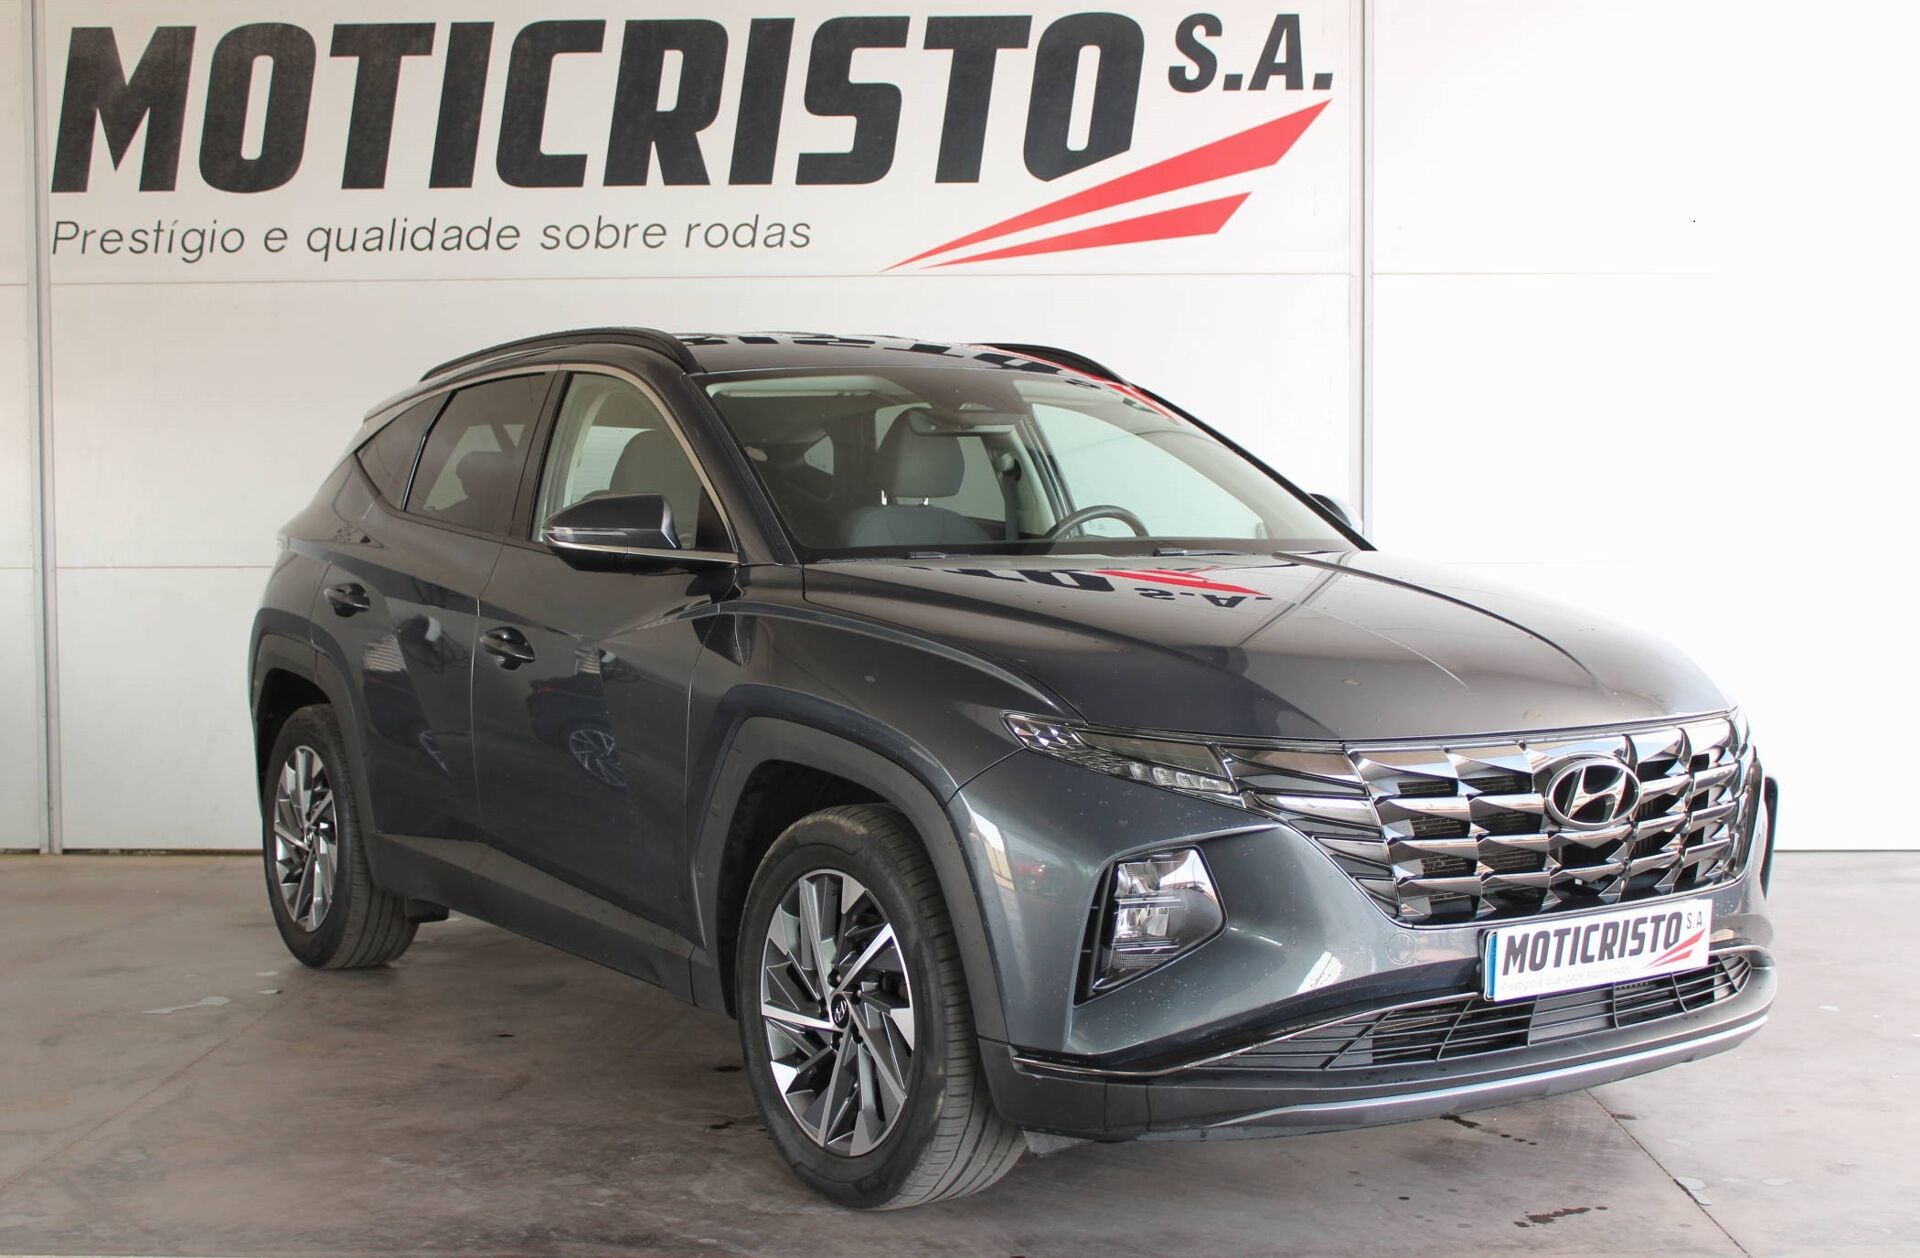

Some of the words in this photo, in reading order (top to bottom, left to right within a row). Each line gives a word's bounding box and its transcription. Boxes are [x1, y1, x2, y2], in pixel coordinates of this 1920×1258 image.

[51, 13, 1145, 193] MOTICRISTO
[1168, 14, 1333, 92] S.A.
[52, 219, 246, 264] Prestígio
[264, 226, 288, 253] e
[306, 216, 521, 262] qualidade
[540, 214, 668, 251] sobre
[685, 214, 811, 249] rodas
[1502, 911, 1683, 976] MOTICRISTO
